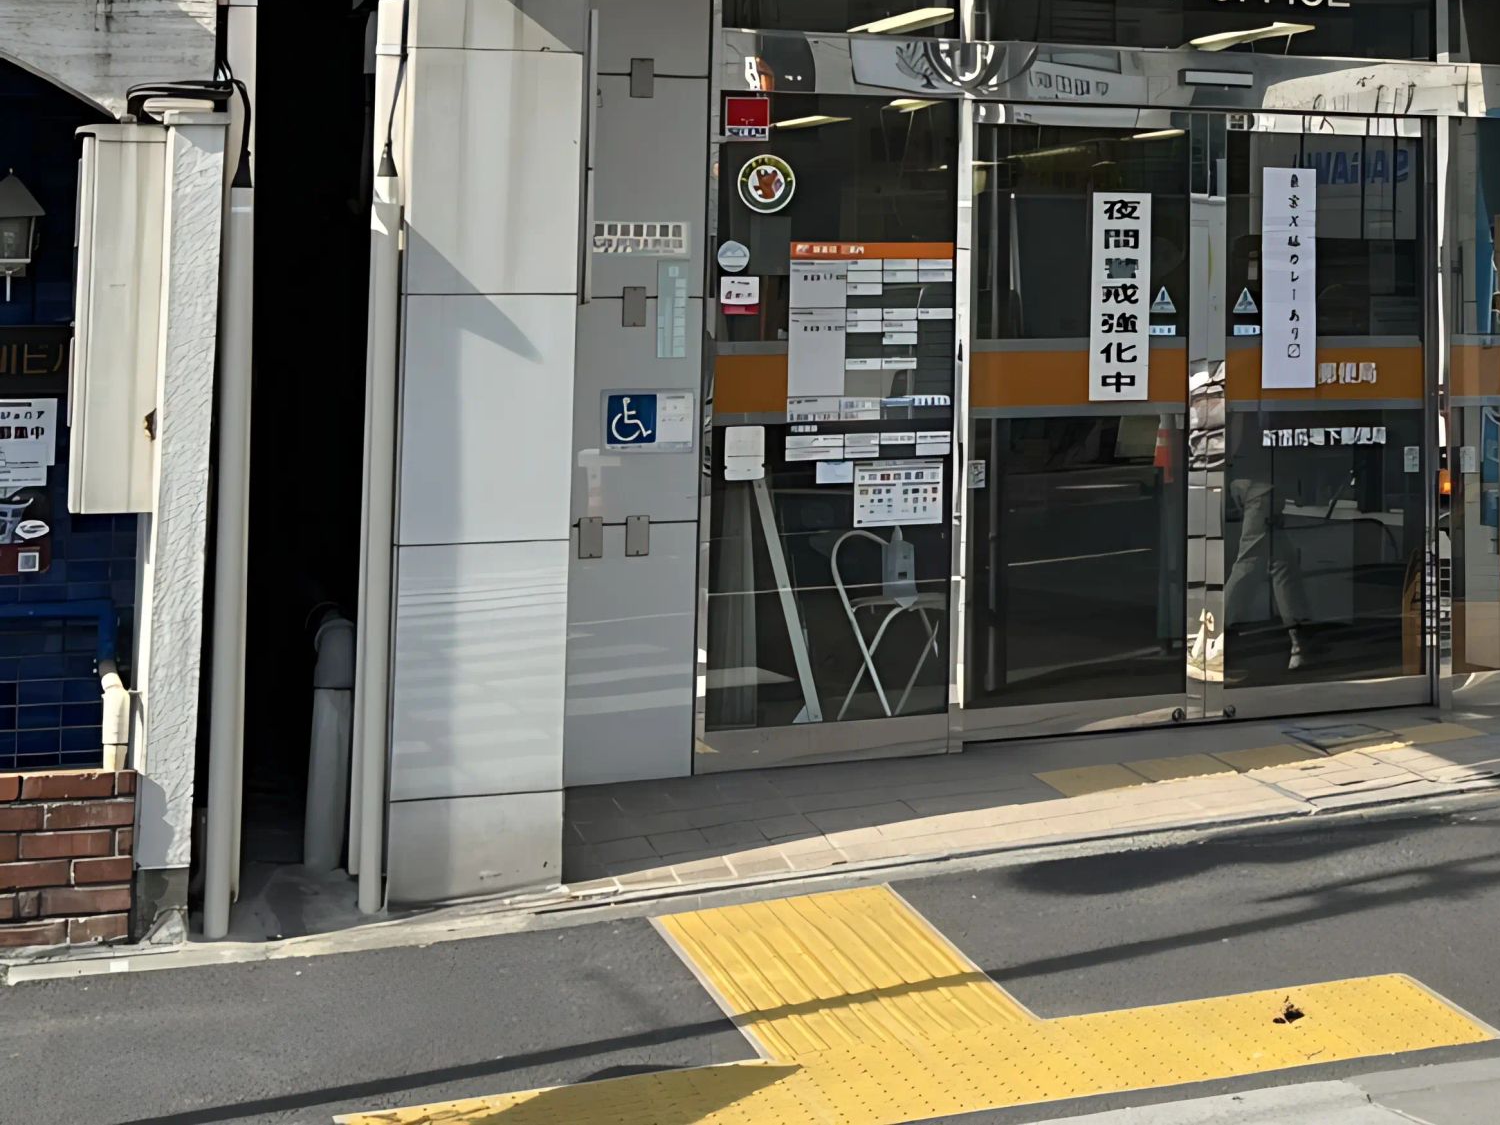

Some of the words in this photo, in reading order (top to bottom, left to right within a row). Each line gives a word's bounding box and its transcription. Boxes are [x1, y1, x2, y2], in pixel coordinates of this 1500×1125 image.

[1099, 198, 1142, 394] 夜間警戒強化中
